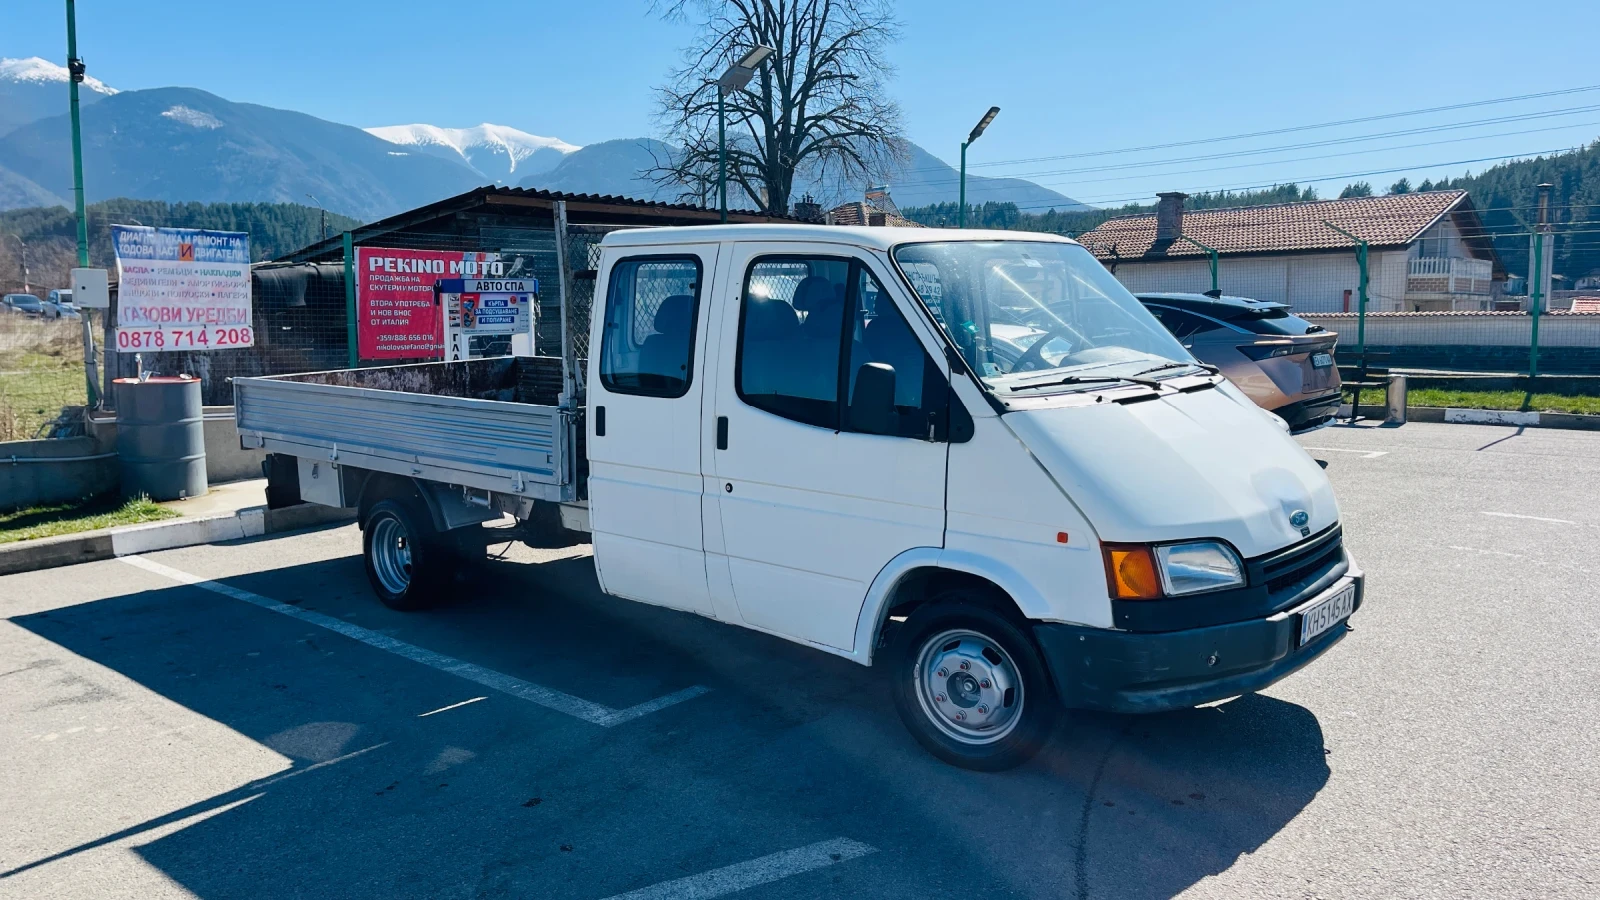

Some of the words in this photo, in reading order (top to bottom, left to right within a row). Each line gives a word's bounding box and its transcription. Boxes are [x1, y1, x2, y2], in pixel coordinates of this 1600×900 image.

[193, 236, 228, 246] РЕМОНТ
[230, 238, 241, 246] НА
[182, 246, 192, 258] И
[194, 248, 243, 259] ДВИГАТЕЛИ
[368, 256, 445, 274] PEKINO
[450, 260, 504, 275] MOTO
[200, 270, 242, 278] НАКЛАДКИ
[476, 282, 502, 291] АВТО
[504, 282, 524, 291] СПА
[124, 306, 182, 322] ГАЗОВИ
[186, 308, 247, 325] УРЕДБИ
[118, 331, 164, 348] 0878
[172, 330, 208, 346] 714
[215, 328, 251, 345] 208
